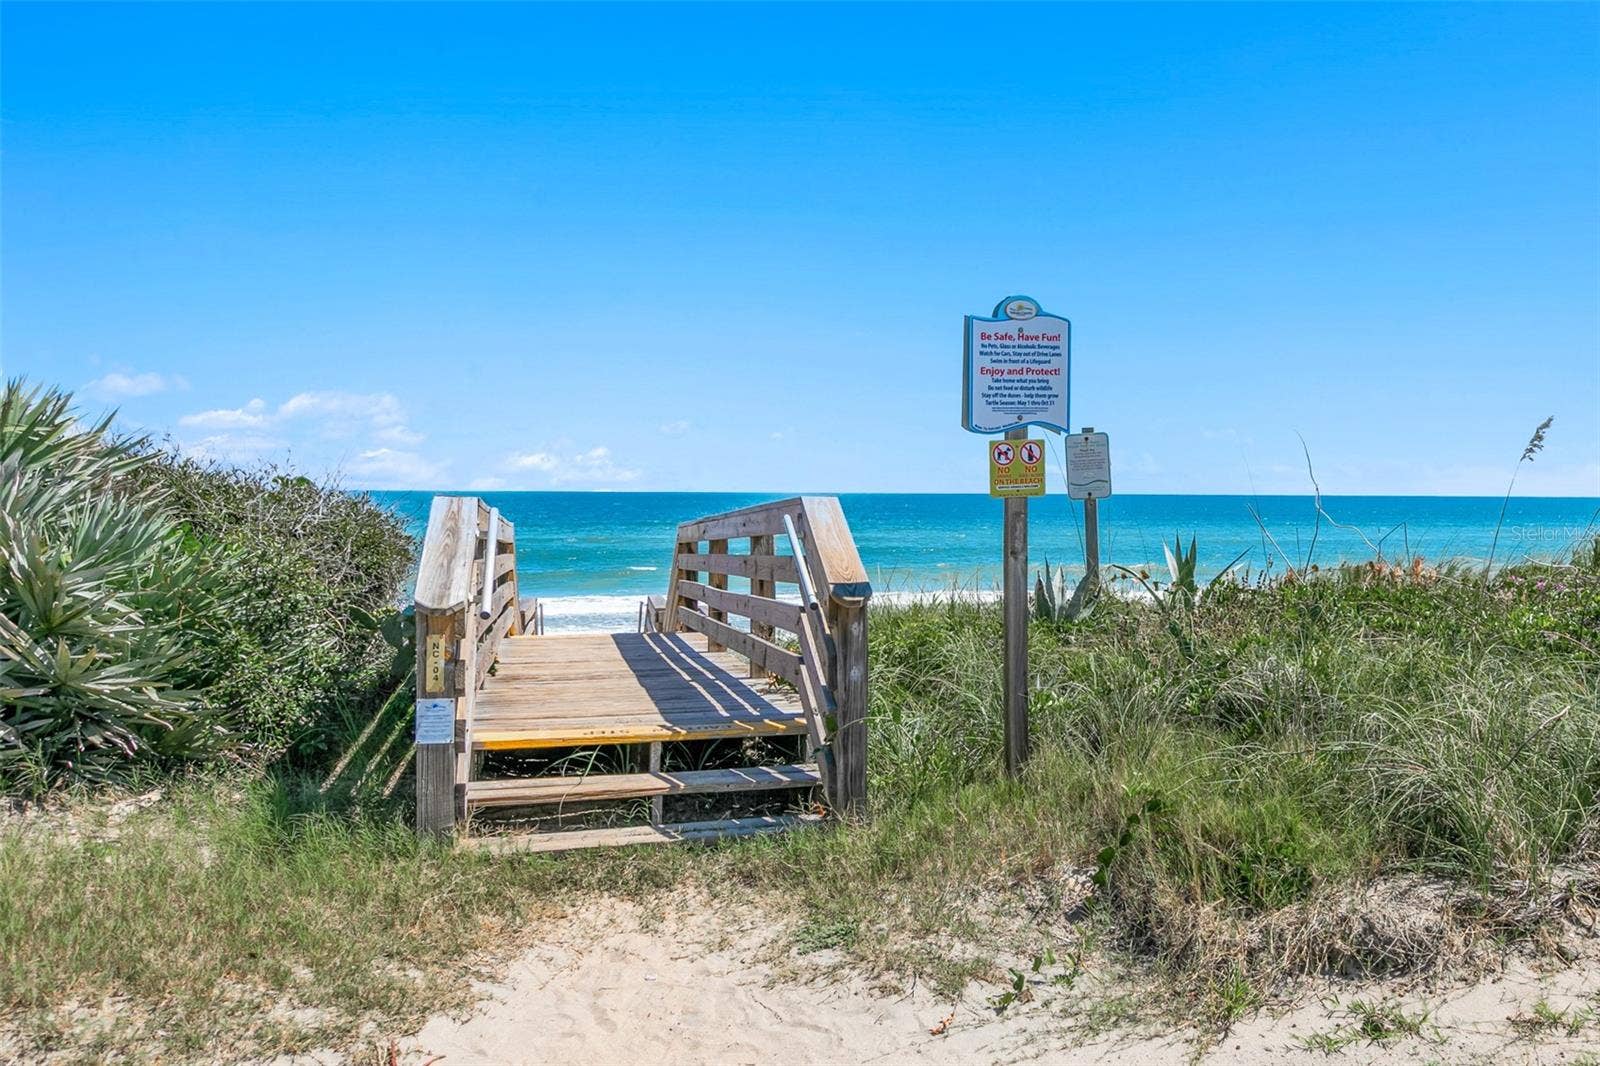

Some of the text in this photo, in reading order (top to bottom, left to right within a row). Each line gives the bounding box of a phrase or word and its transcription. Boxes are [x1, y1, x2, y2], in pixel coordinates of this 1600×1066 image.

[981, 332, 1061, 342] Be Safe, Have Fun!
[1038, 343, 1060, 351] Beverages
[980, 367, 1060, 376] Enjoy and Protect!
